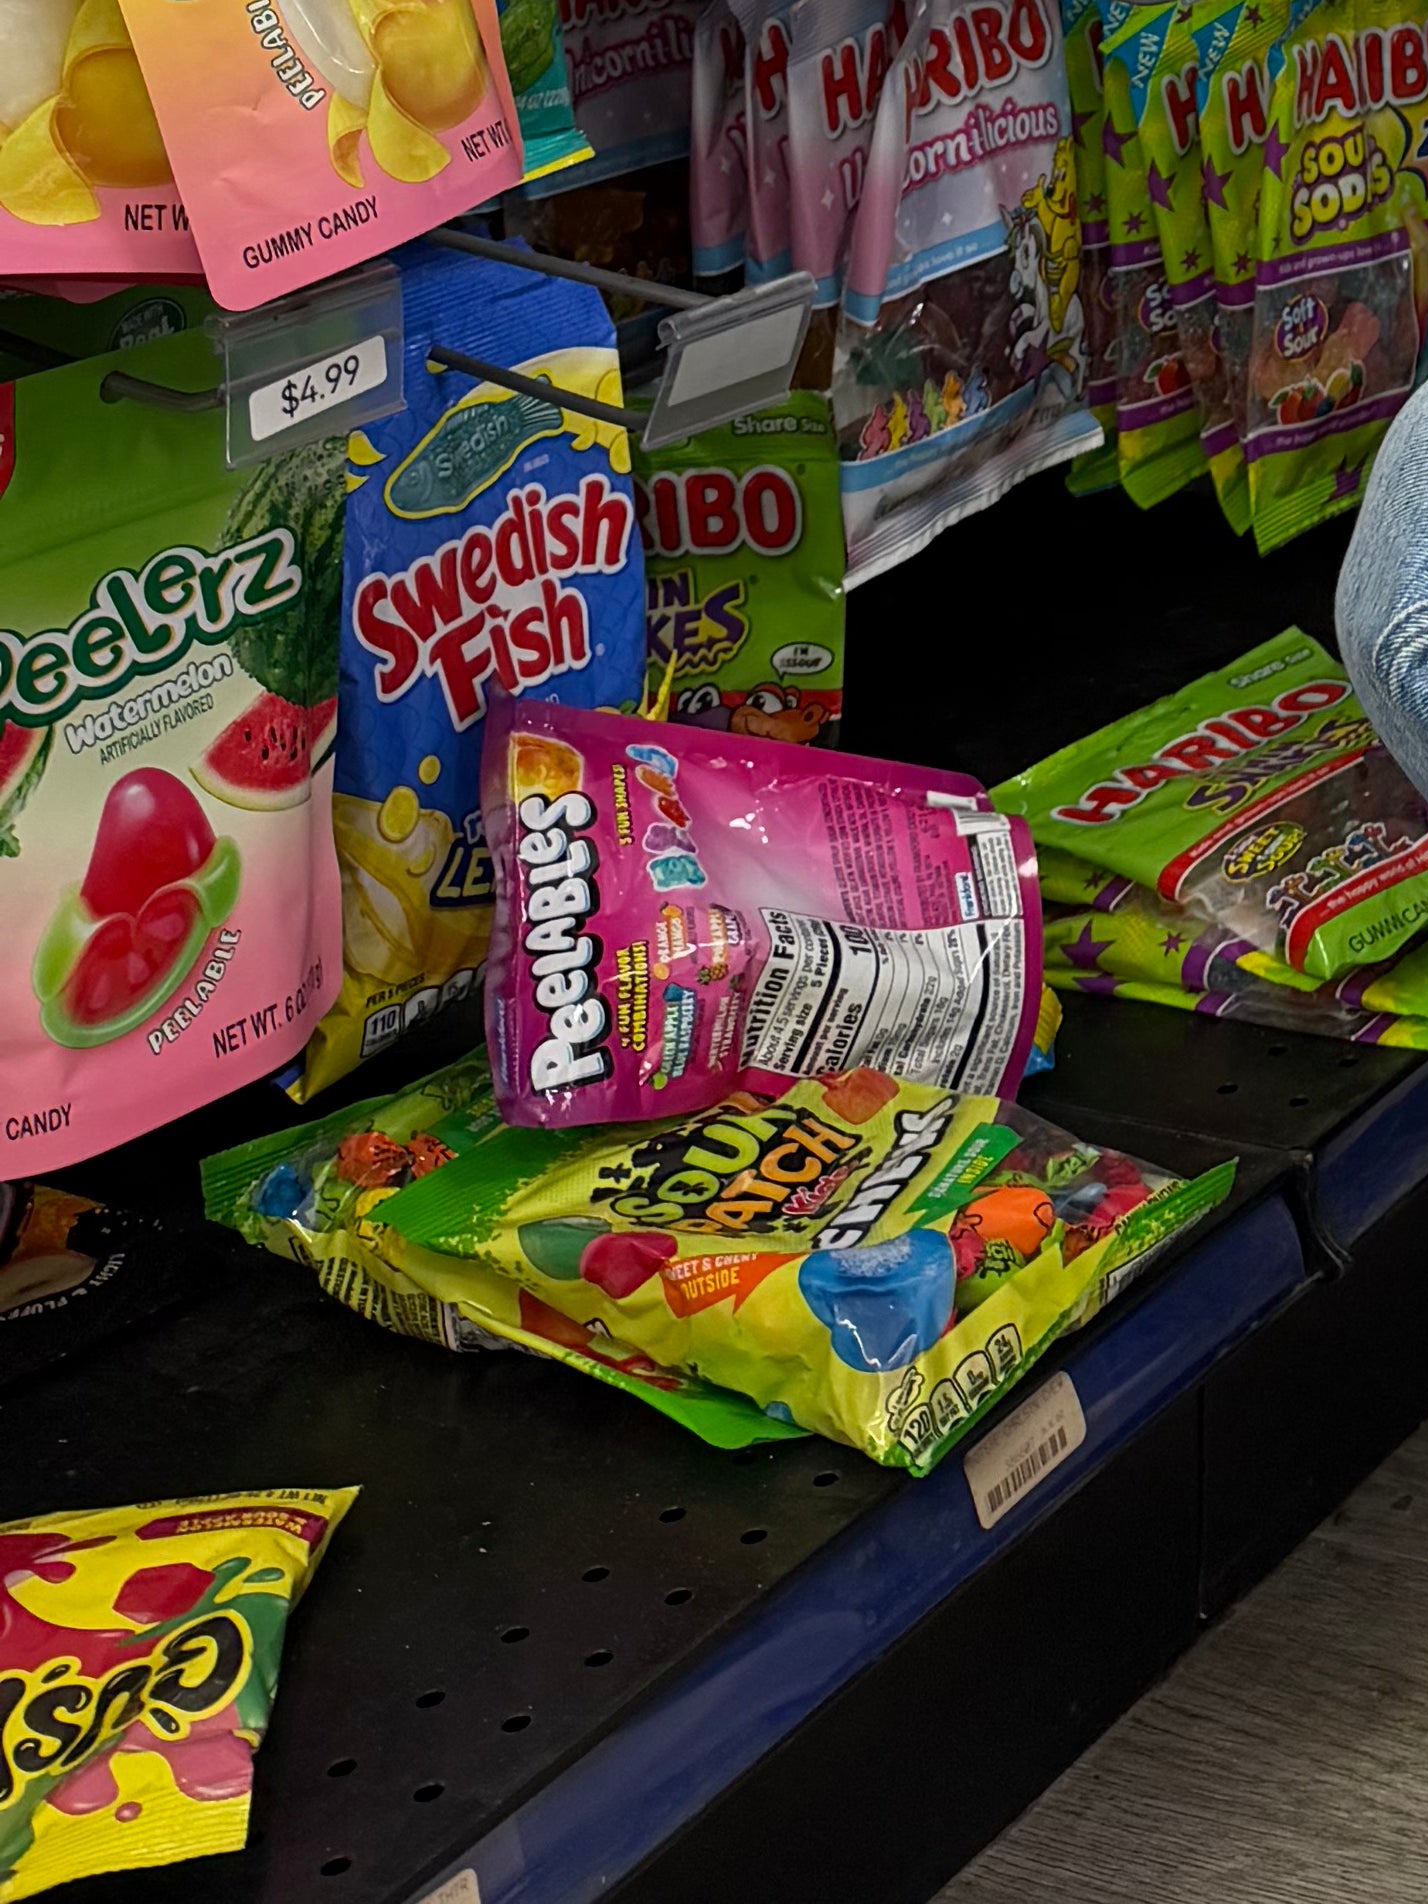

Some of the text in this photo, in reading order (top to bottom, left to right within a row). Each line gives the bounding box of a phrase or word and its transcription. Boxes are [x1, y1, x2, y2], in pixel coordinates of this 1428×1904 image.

[1132, 32, 1161, 87] NEW
[1200, 24, 1231, 82] NEW
[461, 132, 487, 163] NET
[124, 202, 166, 232] NET
[242, 196, 380, 270] GUMMY CANDY
[280, 352, 362, 418] $4.99
[733, 413, 798, 434] Share
[353, 472, 635, 702] Swedish
[429, 579, 597, 732] Fish
[64, 651, 235, 755] Watermelon
[1049, 680, 1354, 827] HARIBO
[765, 910, 795, 960] Facts
[842, 924, 874, 956] 100
[147, 926, 242, 1056] PEELABLE
[212, 1001, 296, 1060] NET WT. 6
[371, 1011, 396, 1036] 110
[775, 1032, 804, 1072] Serving
[5, 1102, 73, 1142] CANDY
[904, 1408, 932, 1445] 120
